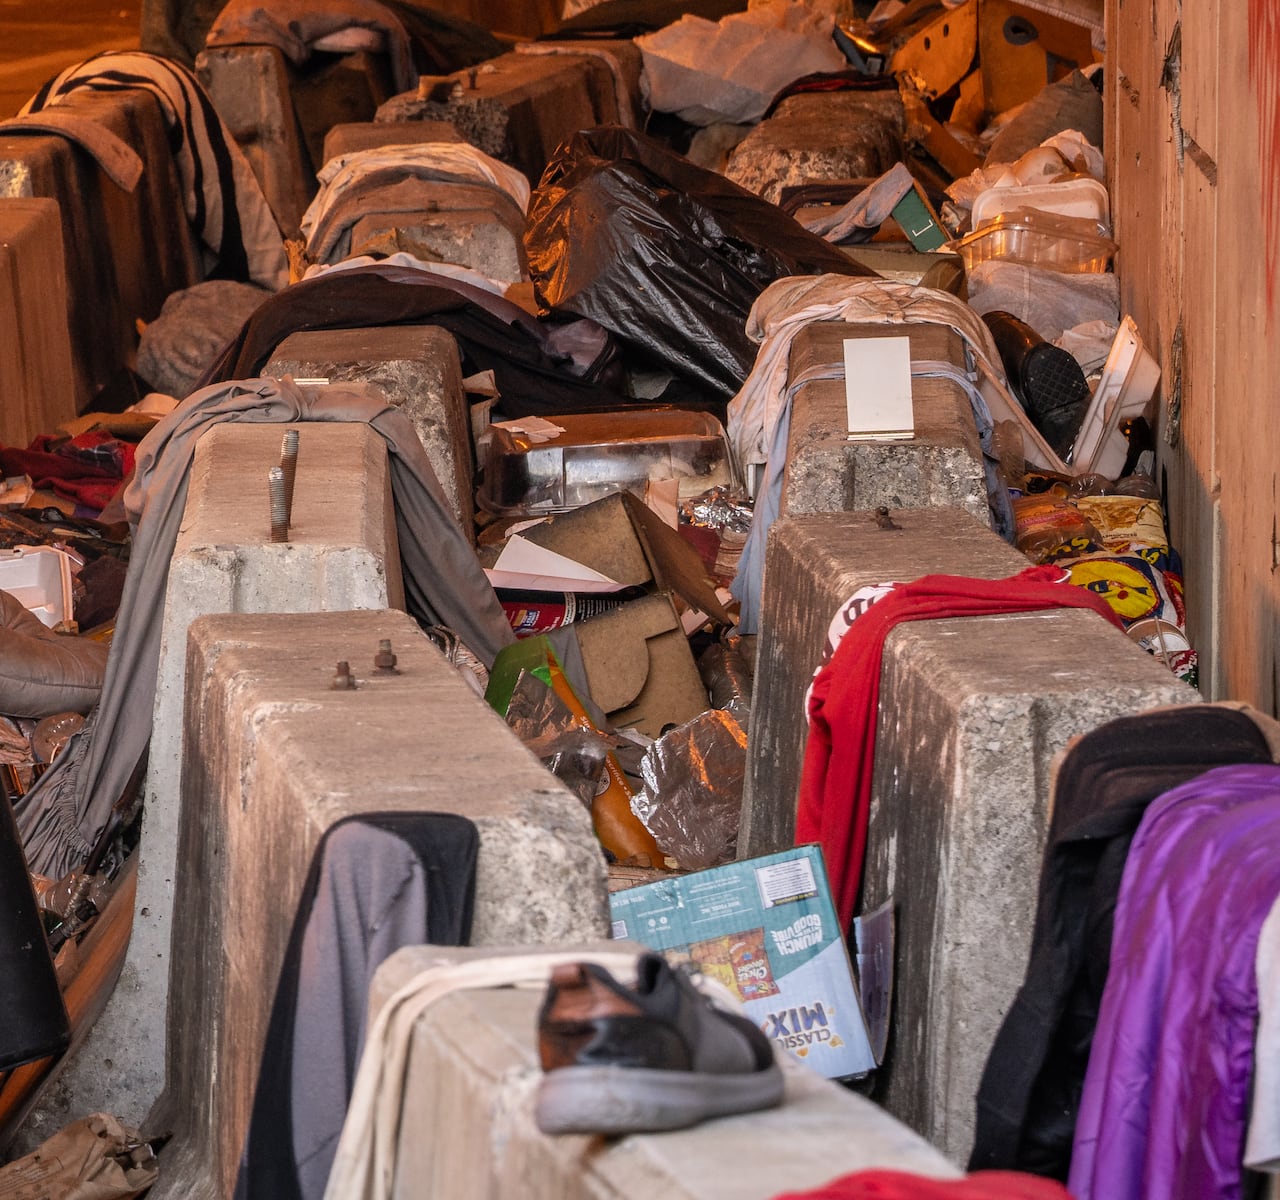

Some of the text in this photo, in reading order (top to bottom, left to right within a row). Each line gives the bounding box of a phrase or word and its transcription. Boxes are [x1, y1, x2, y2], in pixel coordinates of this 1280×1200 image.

[769, 913, 821, 943] GOOD VIBE
[775, 928, 823, 956] MUNCH
[767, 1002, 829, 1039] MIX
